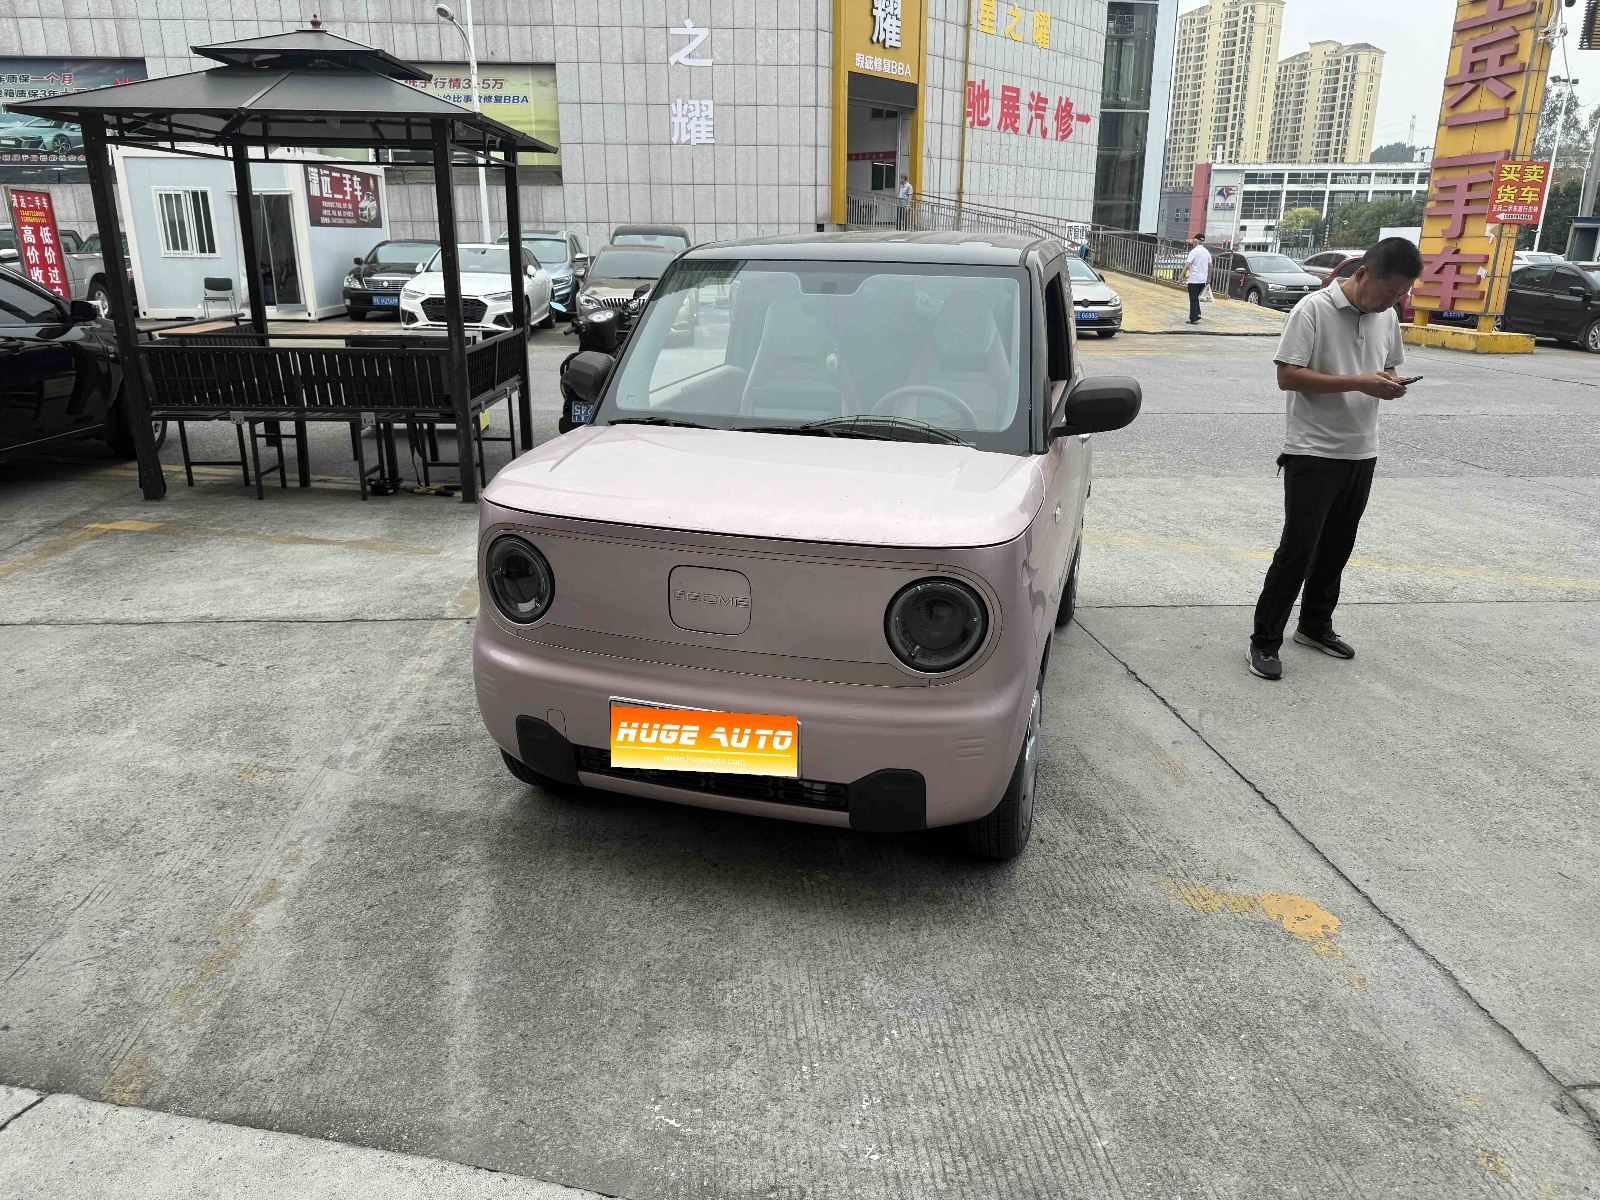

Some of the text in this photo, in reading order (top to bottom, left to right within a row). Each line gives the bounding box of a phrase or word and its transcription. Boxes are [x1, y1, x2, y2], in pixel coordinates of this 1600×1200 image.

[966, 79, 1075, 142] 驰展汽修
[1499, 164, 1545, 183] 买卖
[1495, 185, 1541, 204] 货车
[672, 589, 749, 608] GEOME
